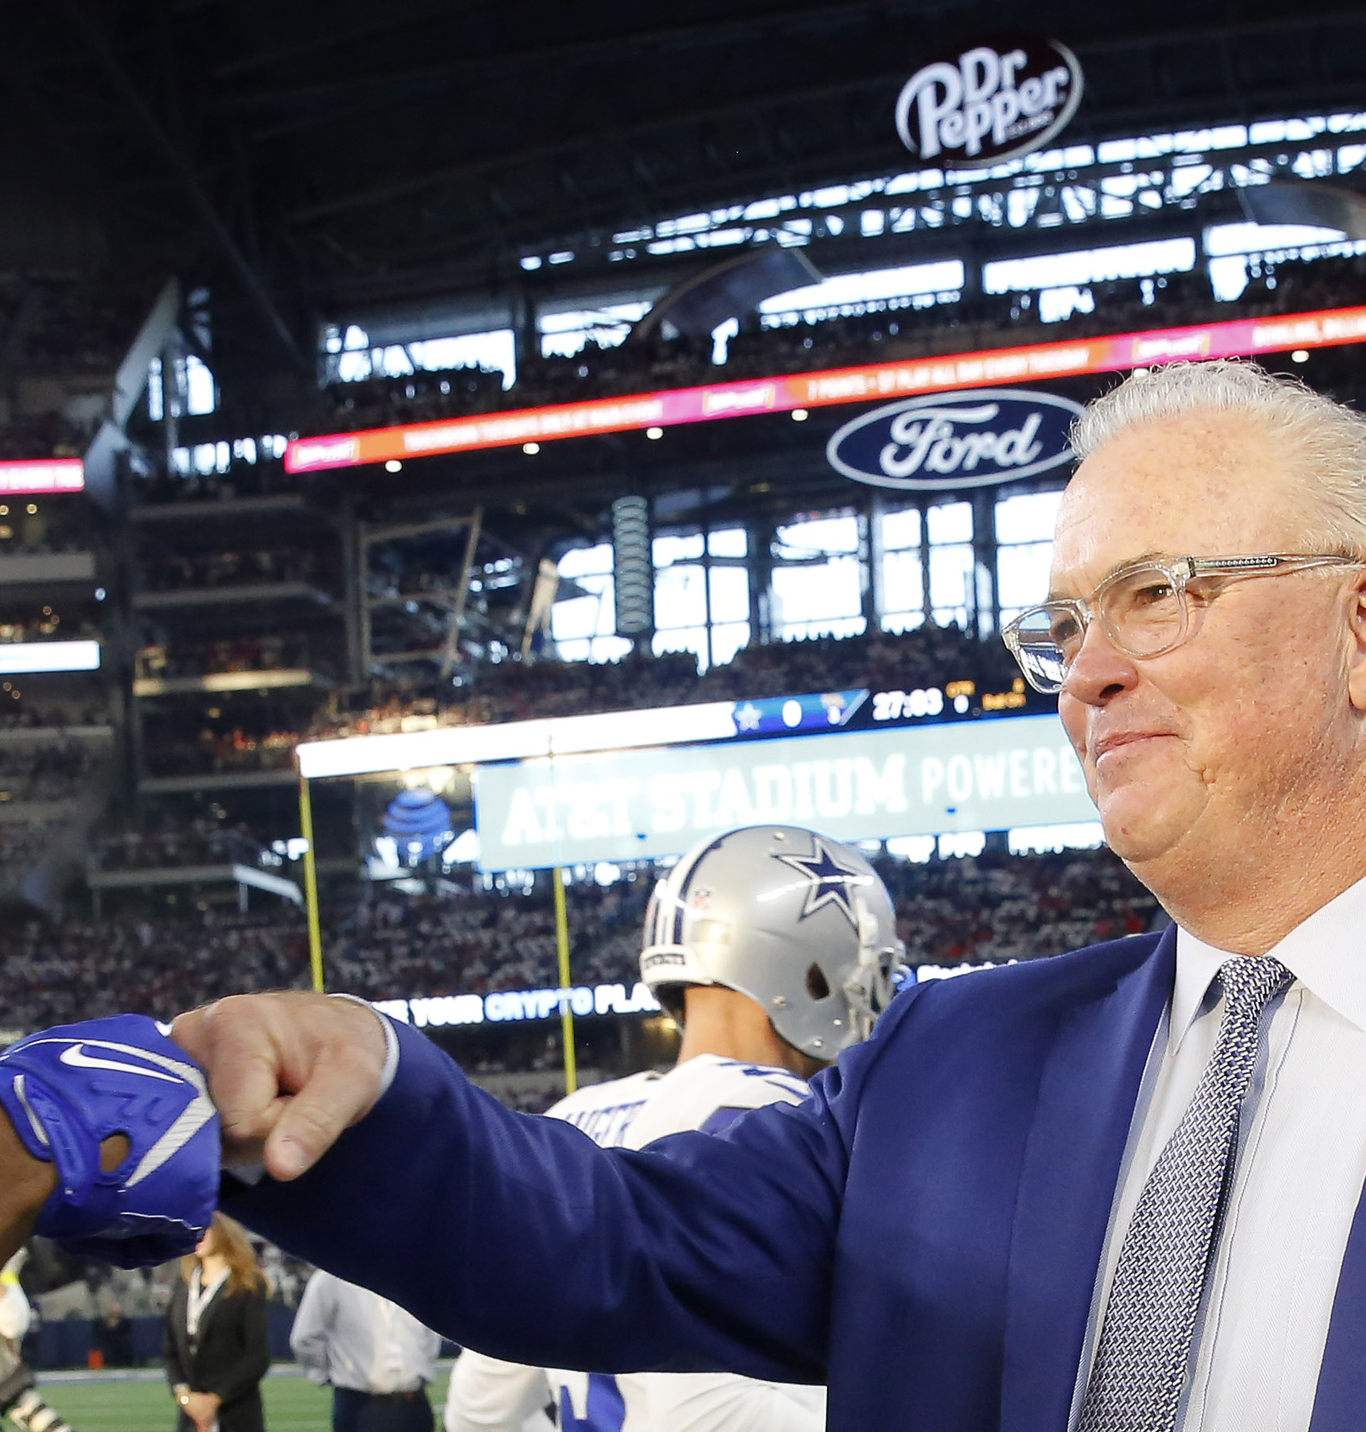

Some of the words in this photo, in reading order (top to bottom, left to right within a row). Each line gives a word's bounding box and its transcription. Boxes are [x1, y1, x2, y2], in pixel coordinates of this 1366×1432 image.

[895, 61, 1069, 160] Pepper
[959, 46, 1028, 101] Dr
[879, 402, 1044, 478] Ford
[502, 777, 640, 846] AT&T
[649, 753, 909, 832] STADIUM
[921, 746, 1082, 804] POWERE
[484, 986, 593, 1022] CRYPTO
[593, 982, 662, 1015] PLA
